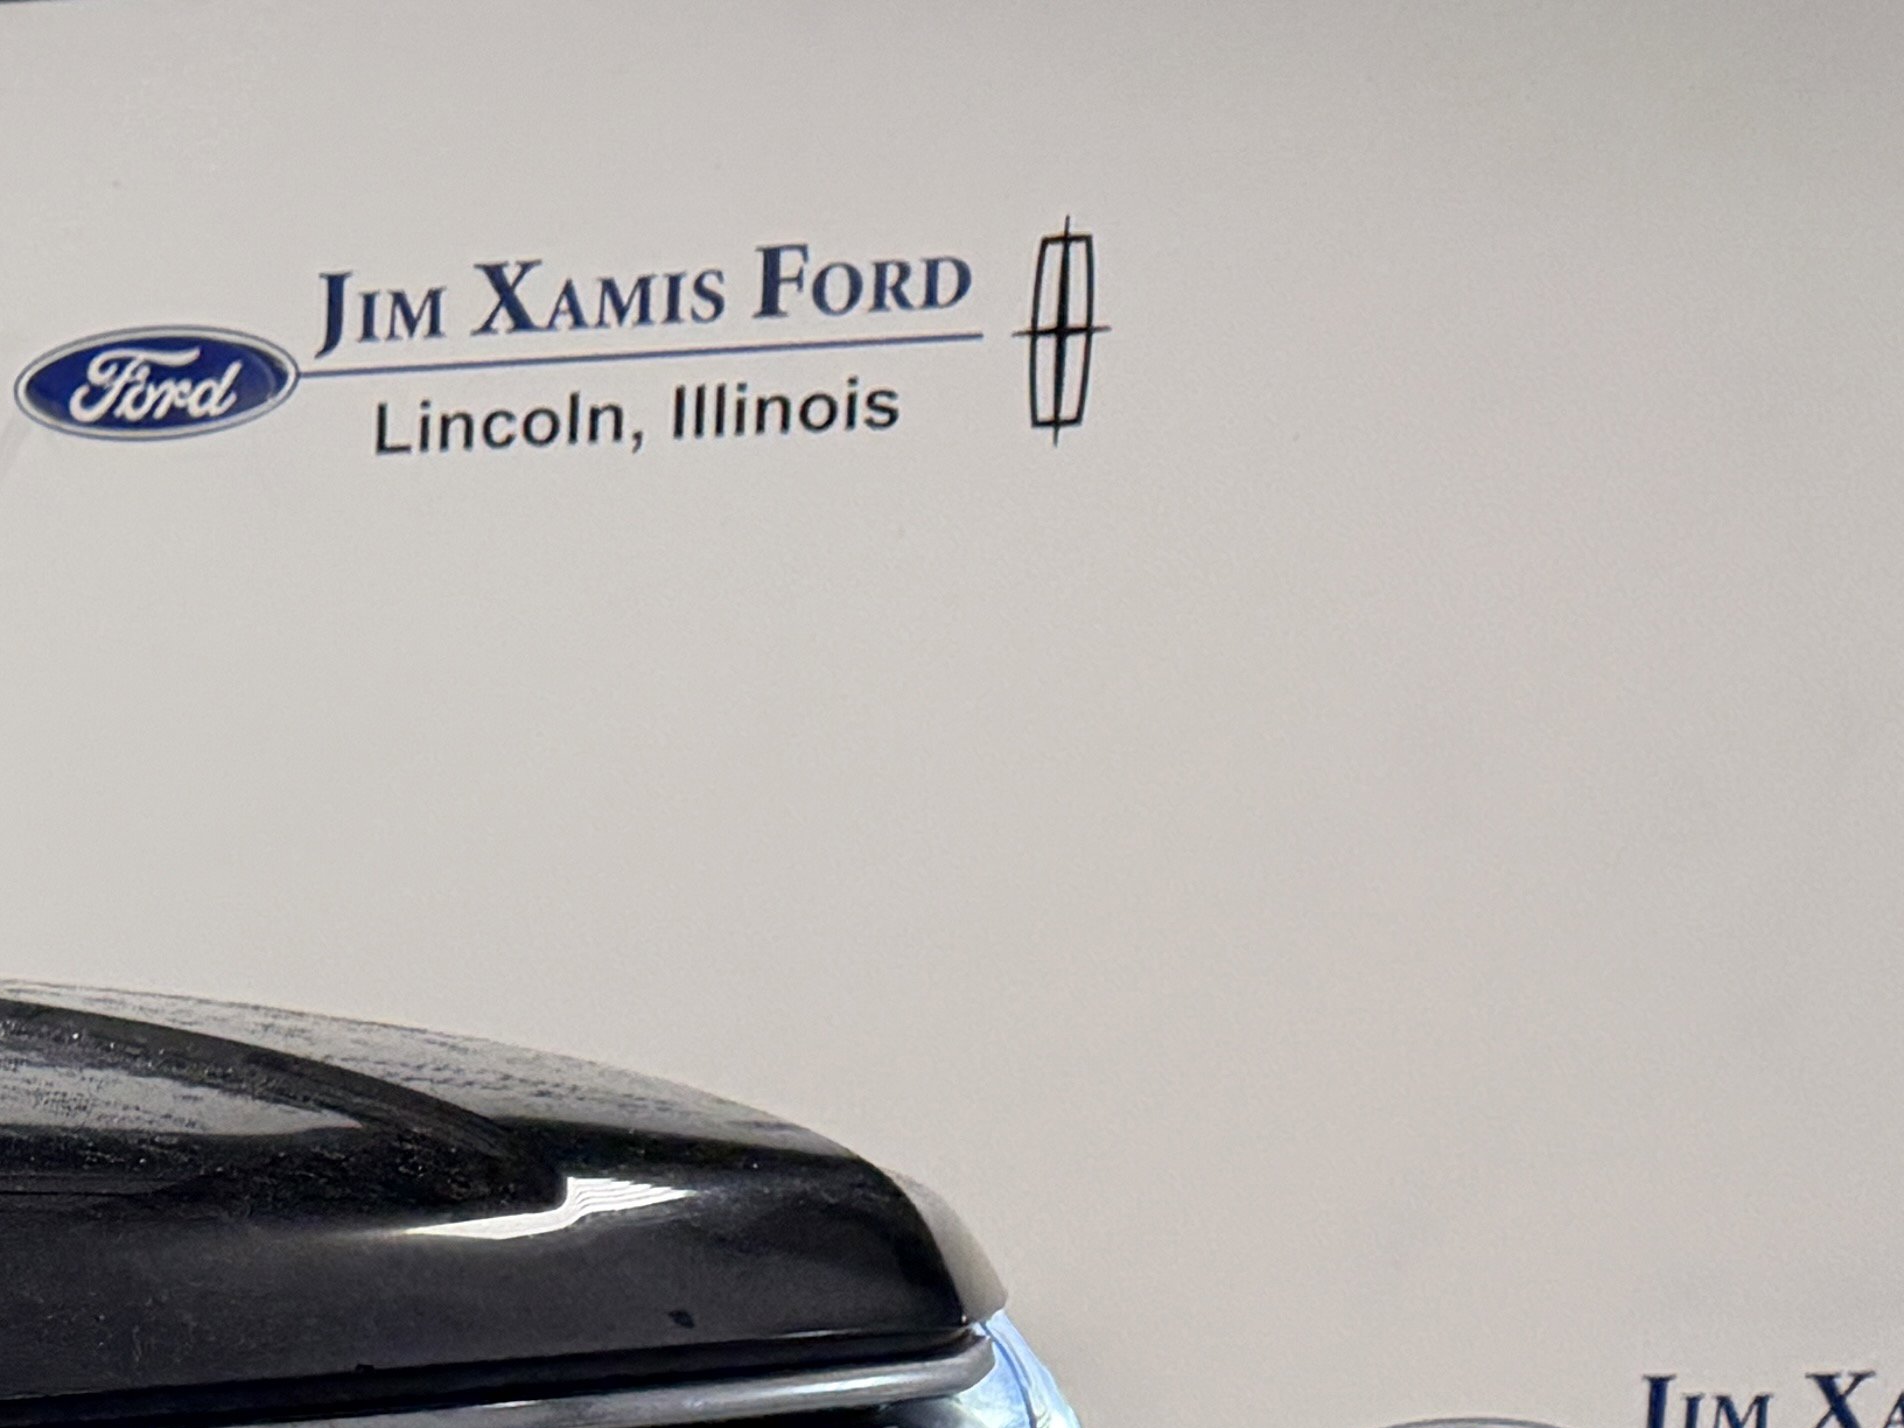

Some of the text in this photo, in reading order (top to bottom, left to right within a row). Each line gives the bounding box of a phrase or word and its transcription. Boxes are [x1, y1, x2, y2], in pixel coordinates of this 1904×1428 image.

[314, 243, 972, 359] JIM XAMIS FORD
[69, 346, 242, 423] Ford
[375, 376, 900, 455] Lincoln, Illinois
